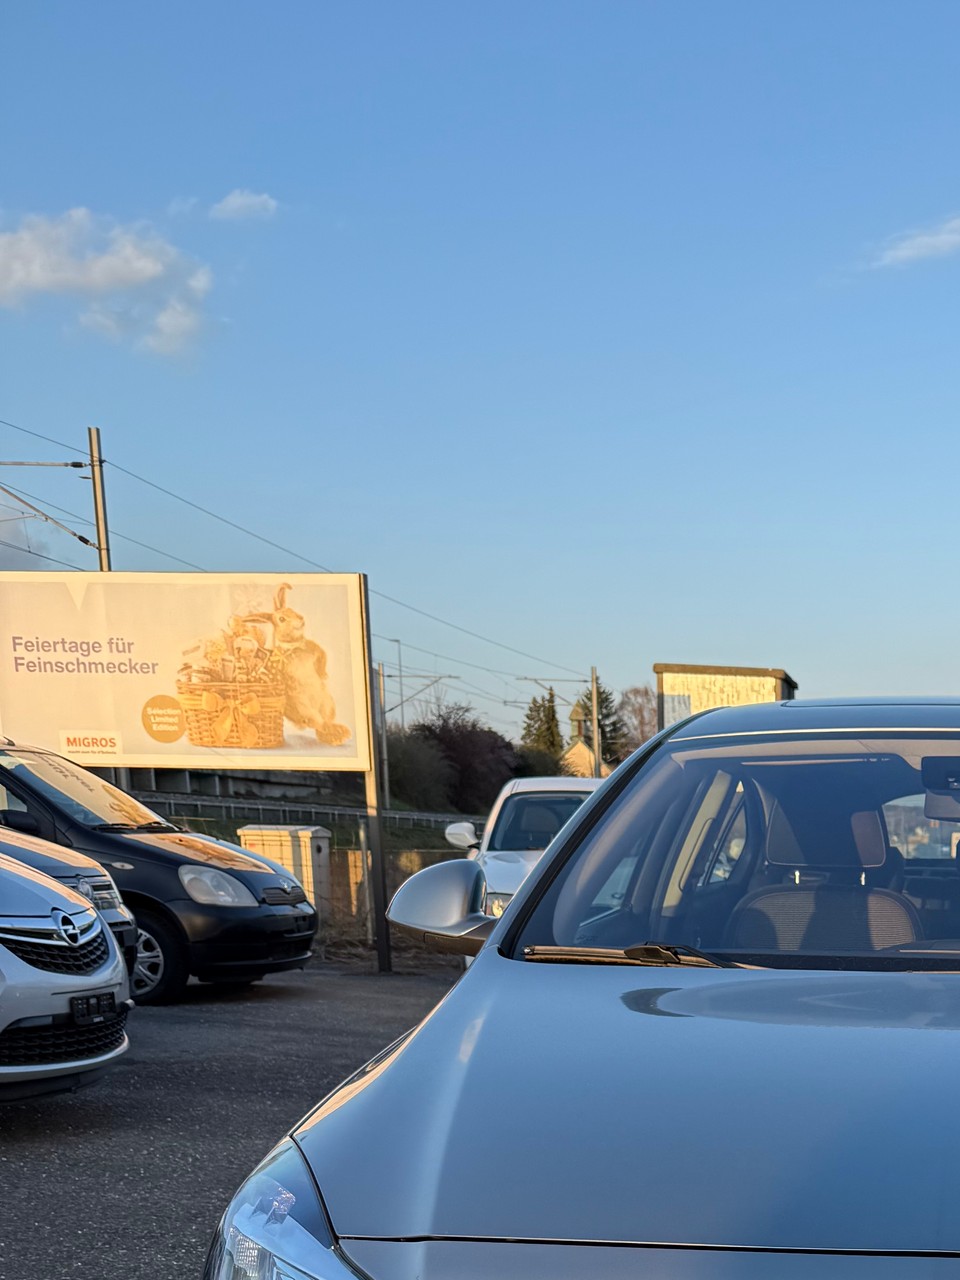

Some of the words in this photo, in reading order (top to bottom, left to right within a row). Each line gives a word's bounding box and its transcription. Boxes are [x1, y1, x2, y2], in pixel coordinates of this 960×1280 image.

[12, 636, 102, 657] Feiertage
[107, 637, 134, 654] für
[14, 656, 159, 674] Feinschmecker
[66, 737, 116, 748] MIGROS
